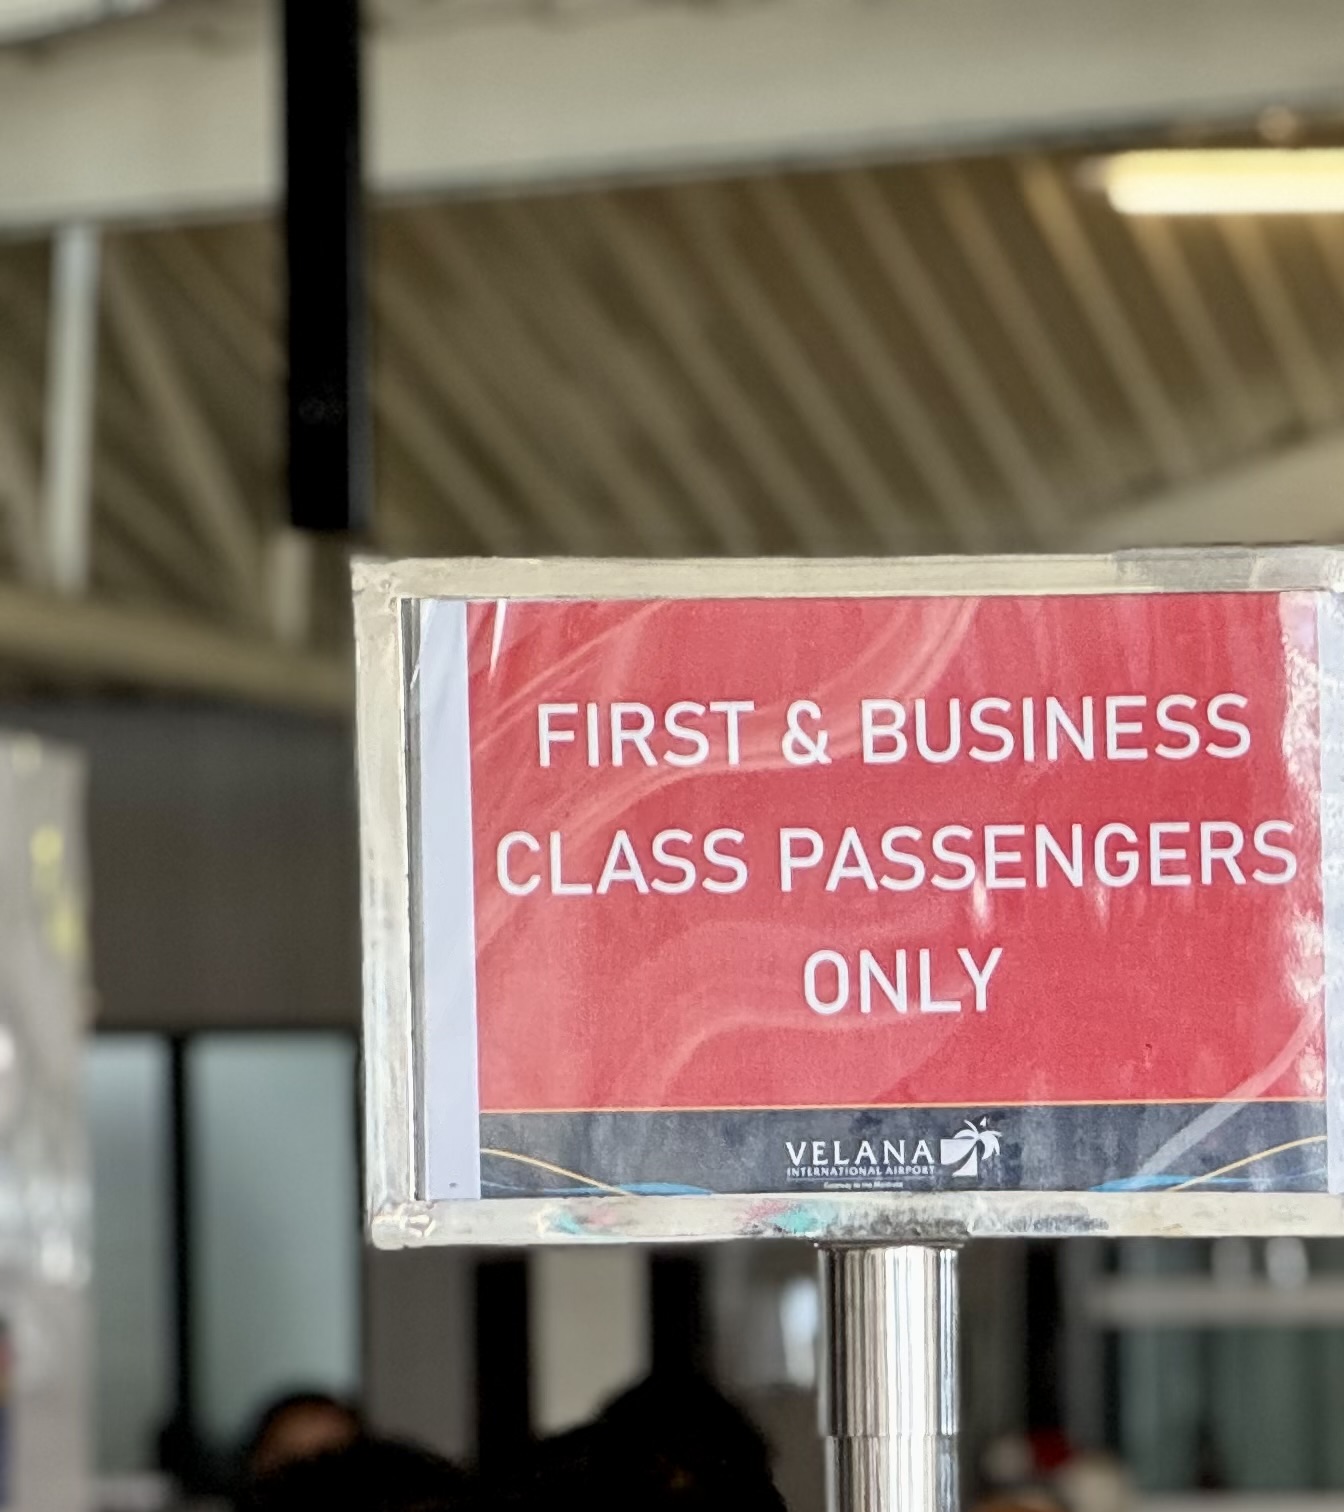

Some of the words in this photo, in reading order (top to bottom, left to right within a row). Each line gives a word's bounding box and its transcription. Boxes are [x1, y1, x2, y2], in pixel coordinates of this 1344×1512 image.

[536, 699, 755, 768] FIRST
[781, 699, 832, 766] &
[861, 693, 1252, 765] BUSINESS
[496, 827, 748, 895] CLASS
[779, 820, 1298, 893] PASSENGERS
[803, 946, 1003, 1015] ONLY
[785, 1139, 935, 1166] VELANA
[786, 1165, 883, 1177] INTERNATIONAL
[885, 1164, 936, 1176] AIRPORT
